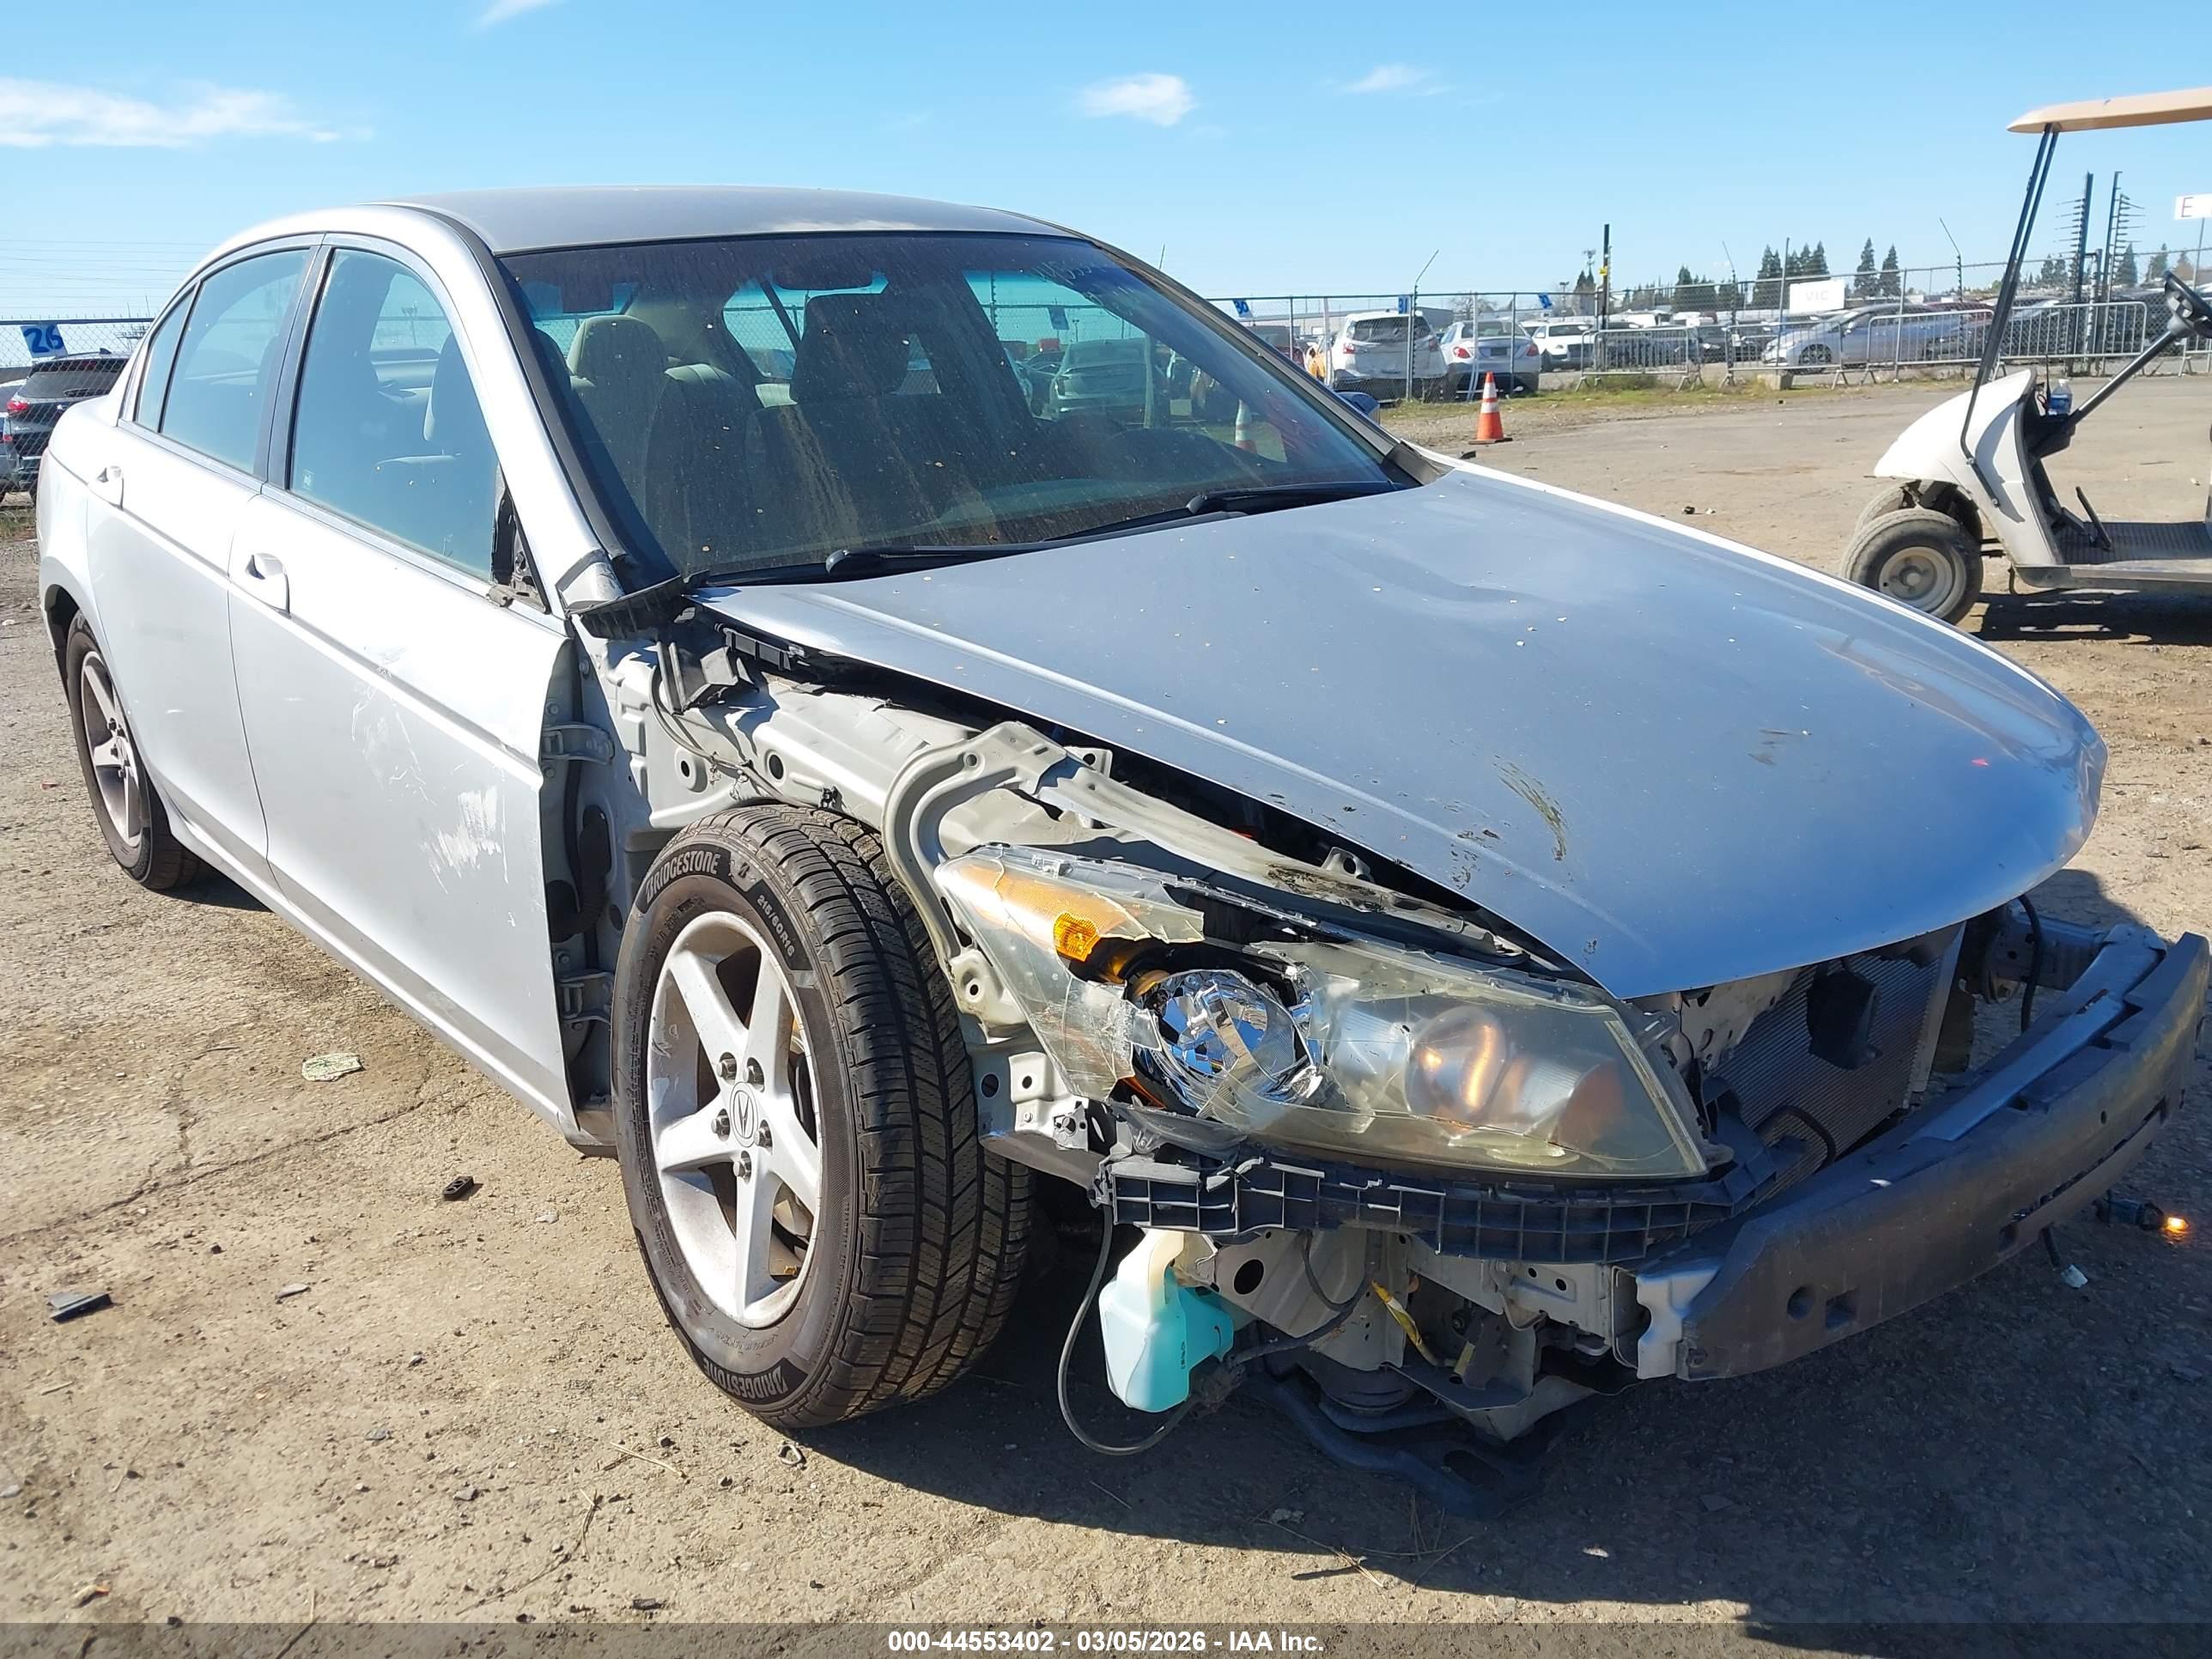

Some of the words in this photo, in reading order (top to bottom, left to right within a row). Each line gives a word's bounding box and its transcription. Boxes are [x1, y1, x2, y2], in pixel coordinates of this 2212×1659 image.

[1233, 300, 1249, 314] 30
[23, 325, 64, 353] 26
[645, 850, 721, 904] BRIDGESTONE
[757, 894, 796, 958] 215/60R16
[702, 1357, 789, 1400] BRIDGESTONE
